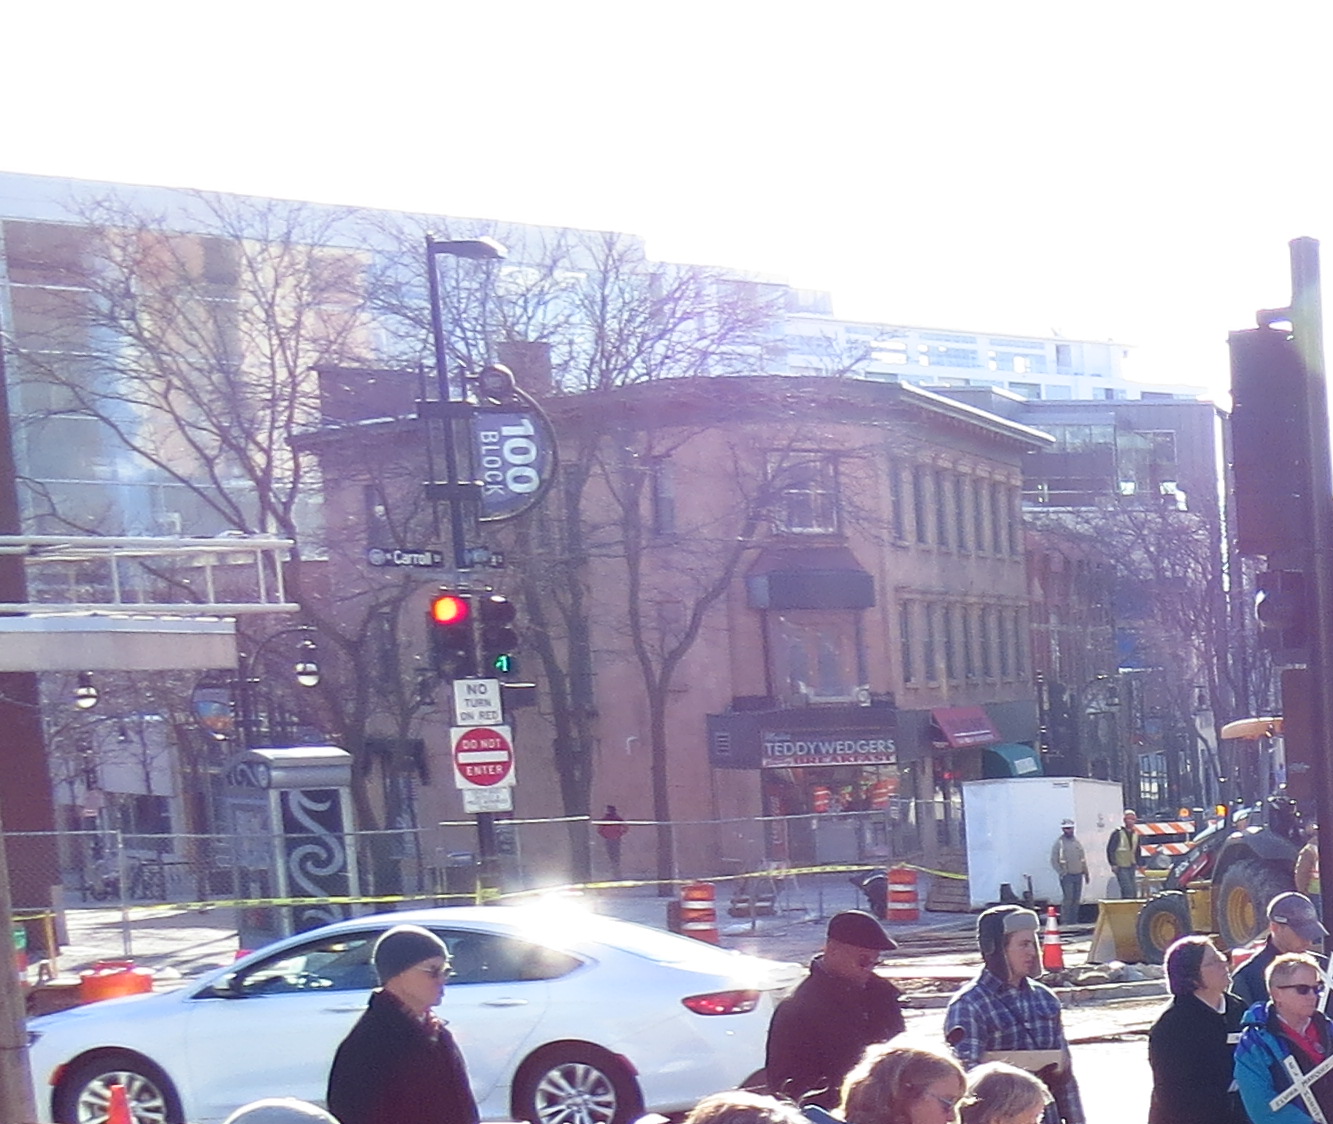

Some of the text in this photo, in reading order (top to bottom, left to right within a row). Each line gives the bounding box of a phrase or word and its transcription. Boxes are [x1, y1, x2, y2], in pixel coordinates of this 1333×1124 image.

[501, 418, 541, 494] 100
[480, 431, 505, 496] BLOCK
[393, 550, 432, 565] Carroll
[466, 683, 488, 695] NO
[464, 698, 492, 708] TURN
[460, 710, 499, 721] ON RED
[462, 738, 501, 750] DO NOT
[465, 765, 504, 776] ENTER
